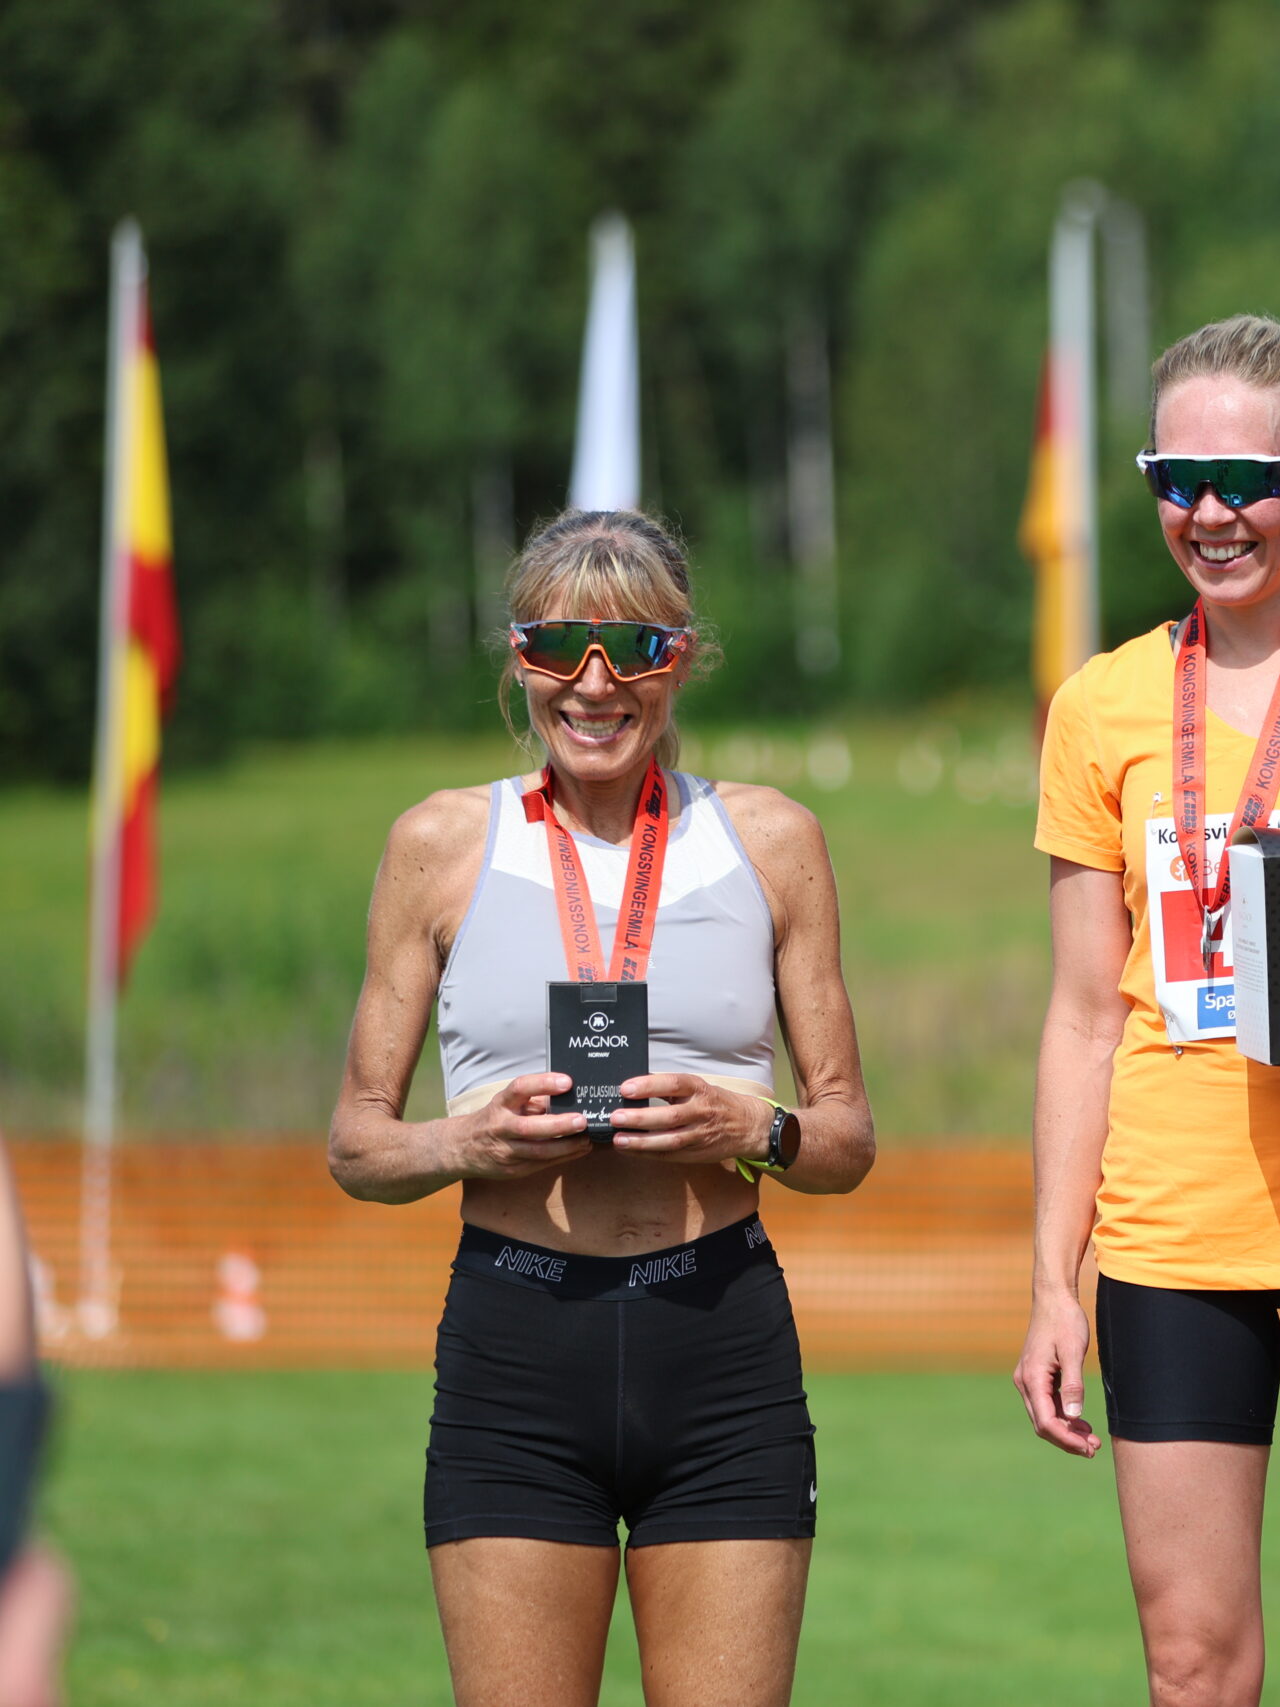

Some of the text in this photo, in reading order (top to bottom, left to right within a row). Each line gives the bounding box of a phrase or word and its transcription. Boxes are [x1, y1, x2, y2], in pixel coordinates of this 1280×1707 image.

[1181, 652, 1197, 785] KONGSVINGERMILA
[624, 824, 657, 950] KONGSVINGERMILA
[569, 1035, 629, 1049] MAGNOR
[576, 1085, 588, 1098] CAP
[494, 1245, 567, 1282] NIKE
[628, 1249, 697, 1287] NIKE
